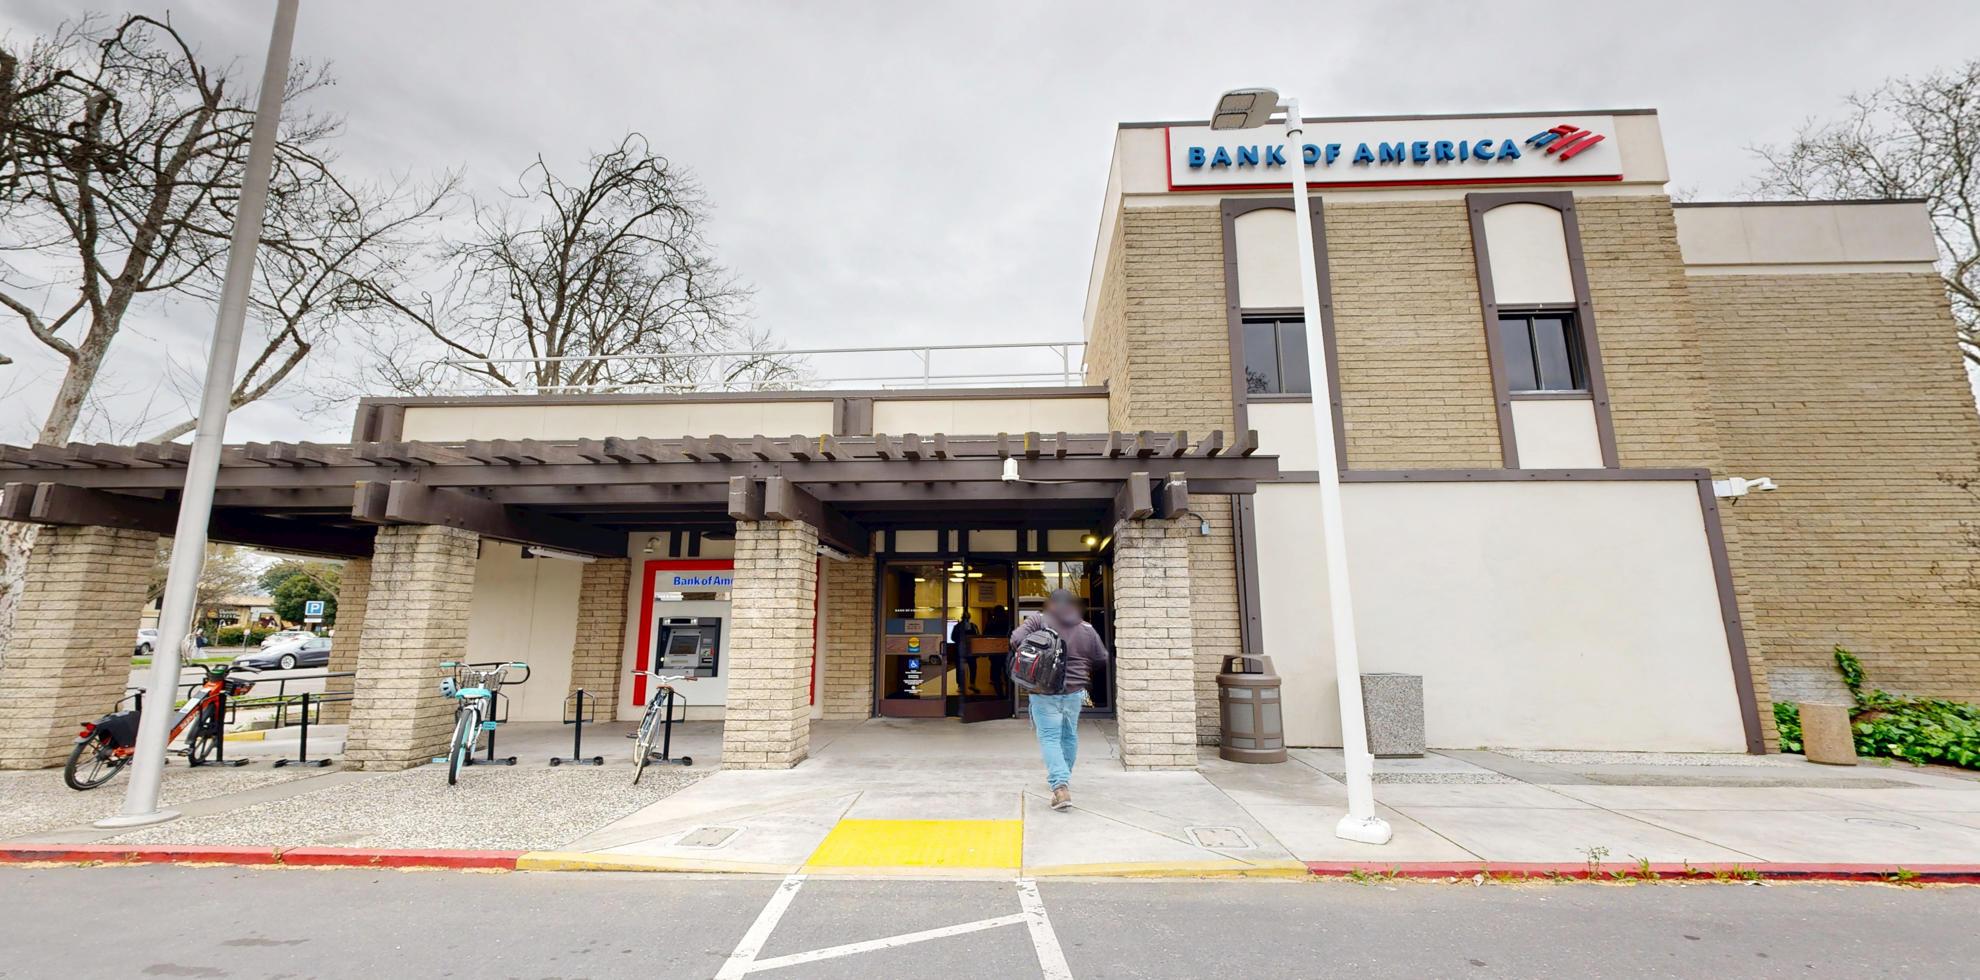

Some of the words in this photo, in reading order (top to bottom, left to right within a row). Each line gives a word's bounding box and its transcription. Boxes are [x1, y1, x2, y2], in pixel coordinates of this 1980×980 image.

[1188, 144, 1287, 168] BANK
[1302, 143, 1342, 166] OF
[1352, 138, 1522, 164] AMERICA
[673, 576, 700, 586] Bank
[701, 576, 713, 586] of
[310, 603, 321, 613] P
